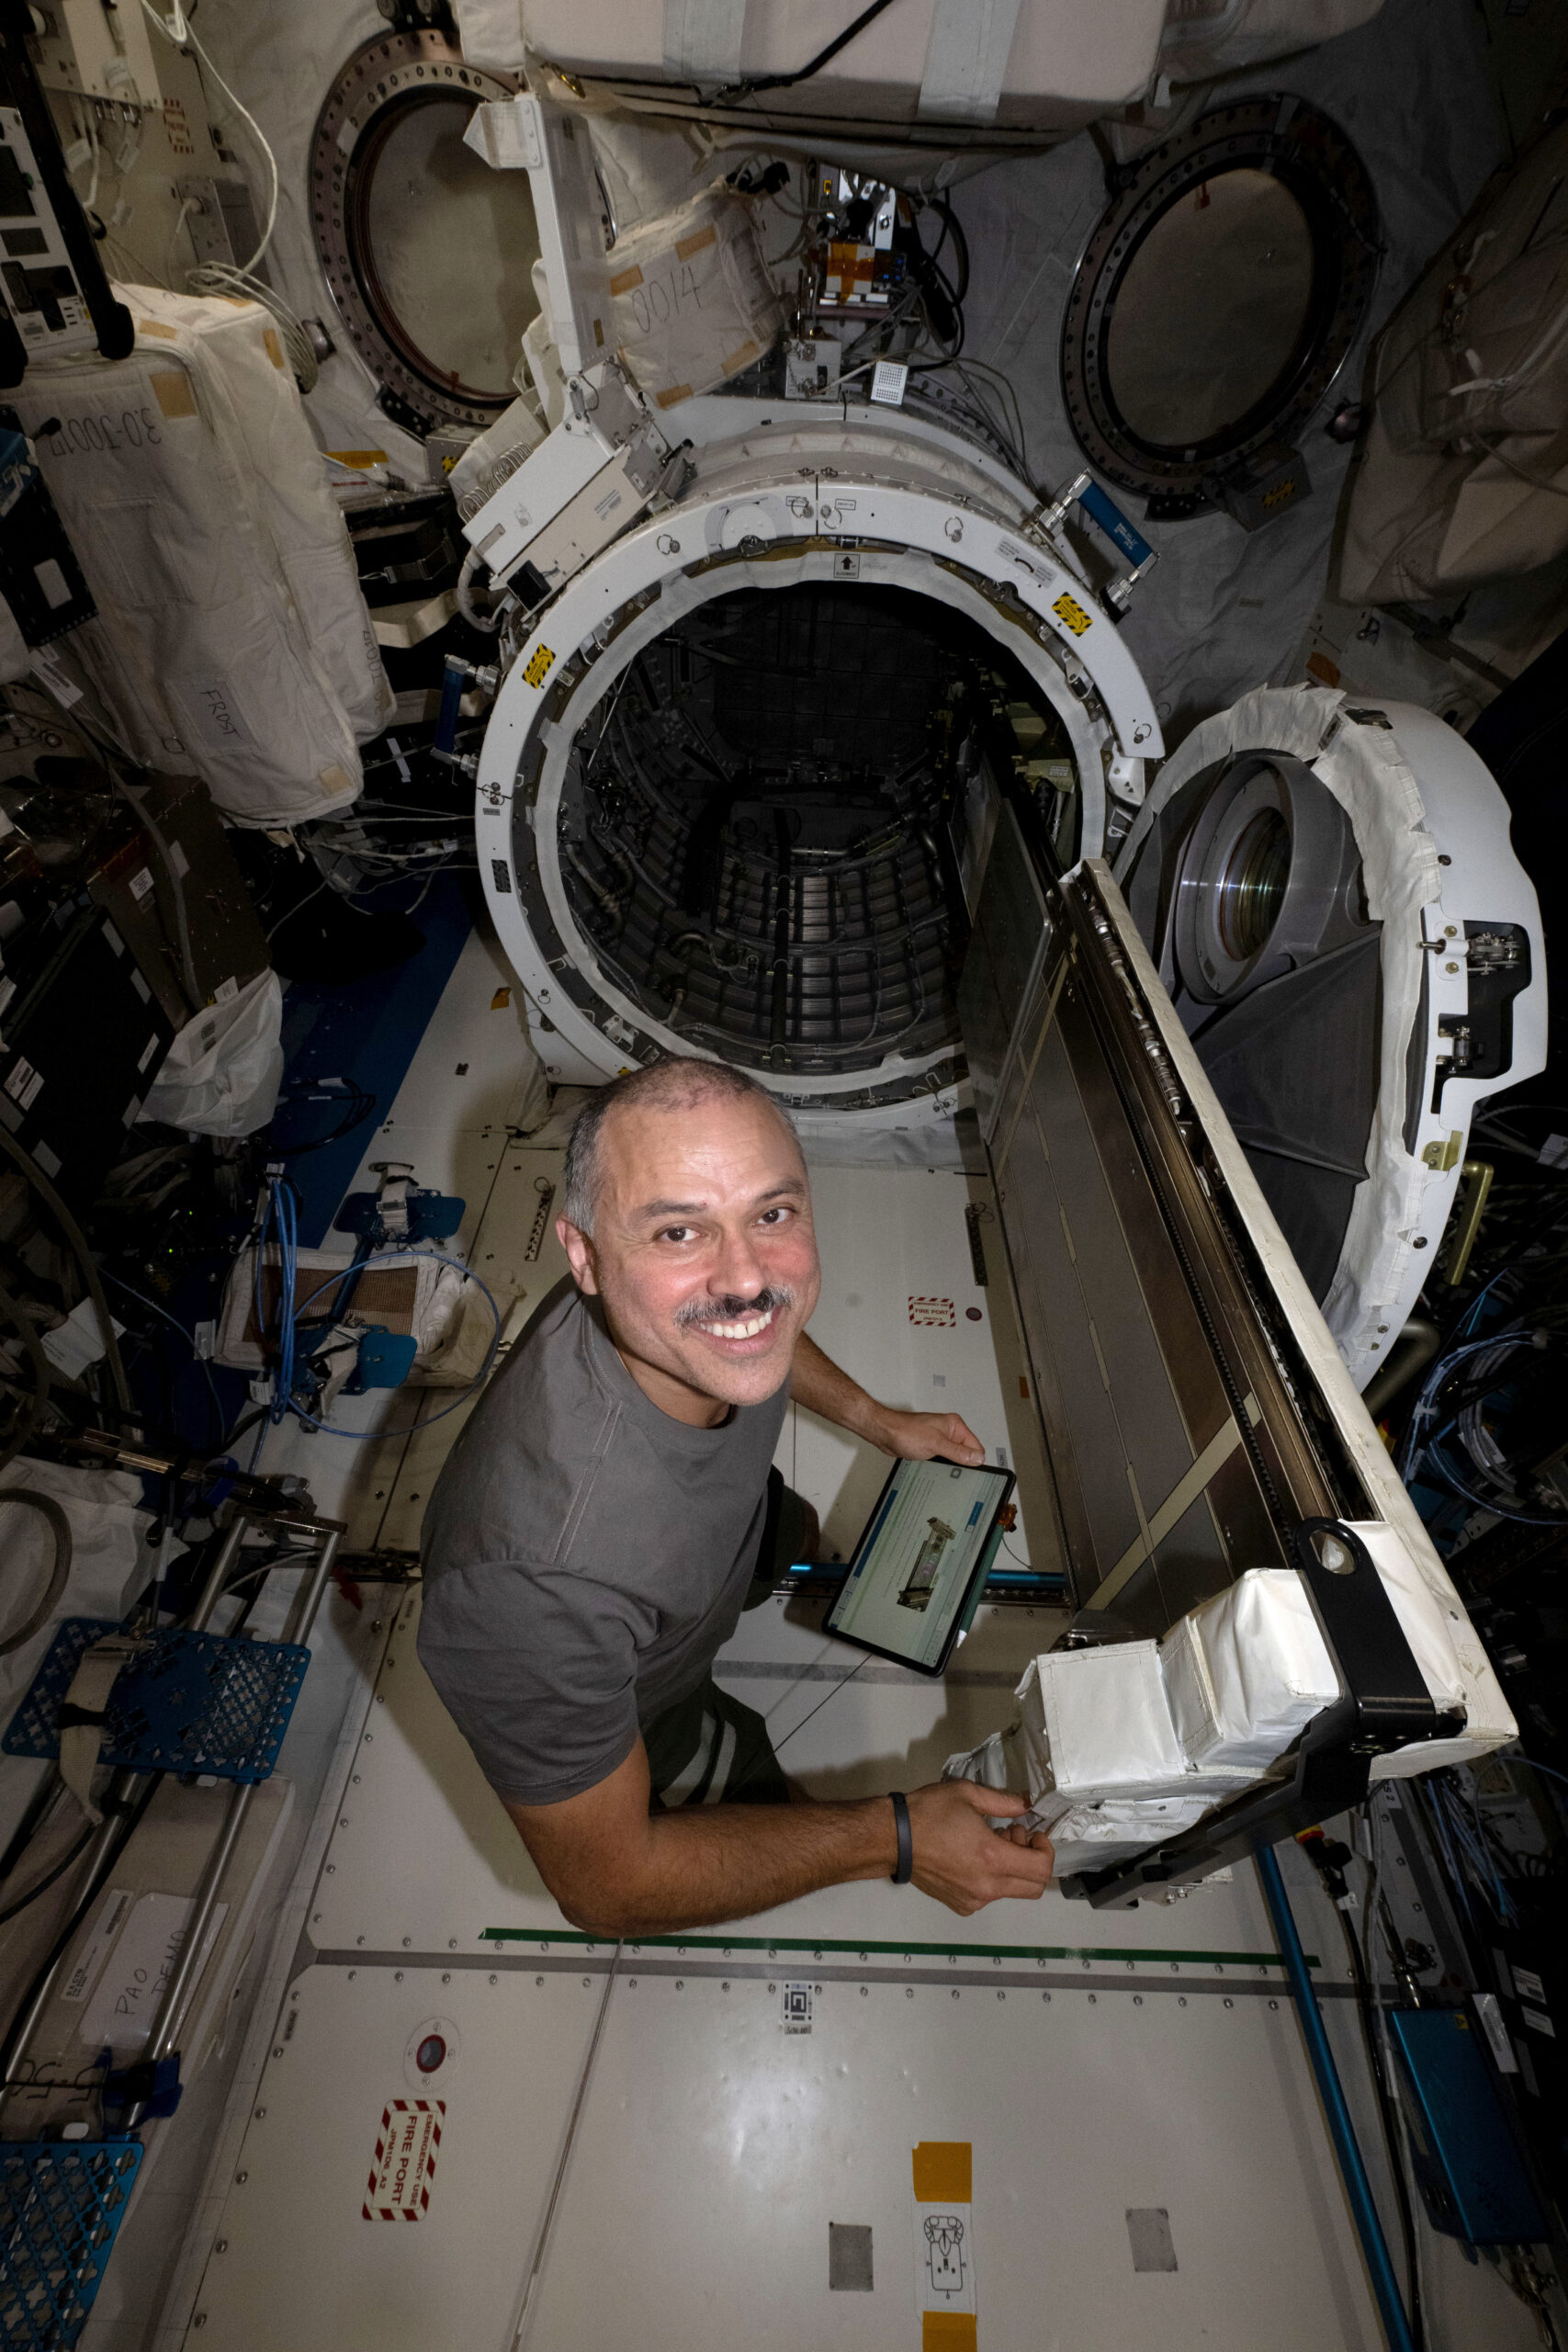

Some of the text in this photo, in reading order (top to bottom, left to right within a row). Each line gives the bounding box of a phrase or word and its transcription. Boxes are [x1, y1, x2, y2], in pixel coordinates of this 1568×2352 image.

[631, 266, 701, 333] 0014
[199, 689, 246, 741] FROST
[115, 1968, 149, 2016] PAO
[152, 1929, 185, 1997] DEMO
[391, 2116, 417, 2204] FIRE PORT
[410, 2114, 434, 2206] EMERGENCY USE
